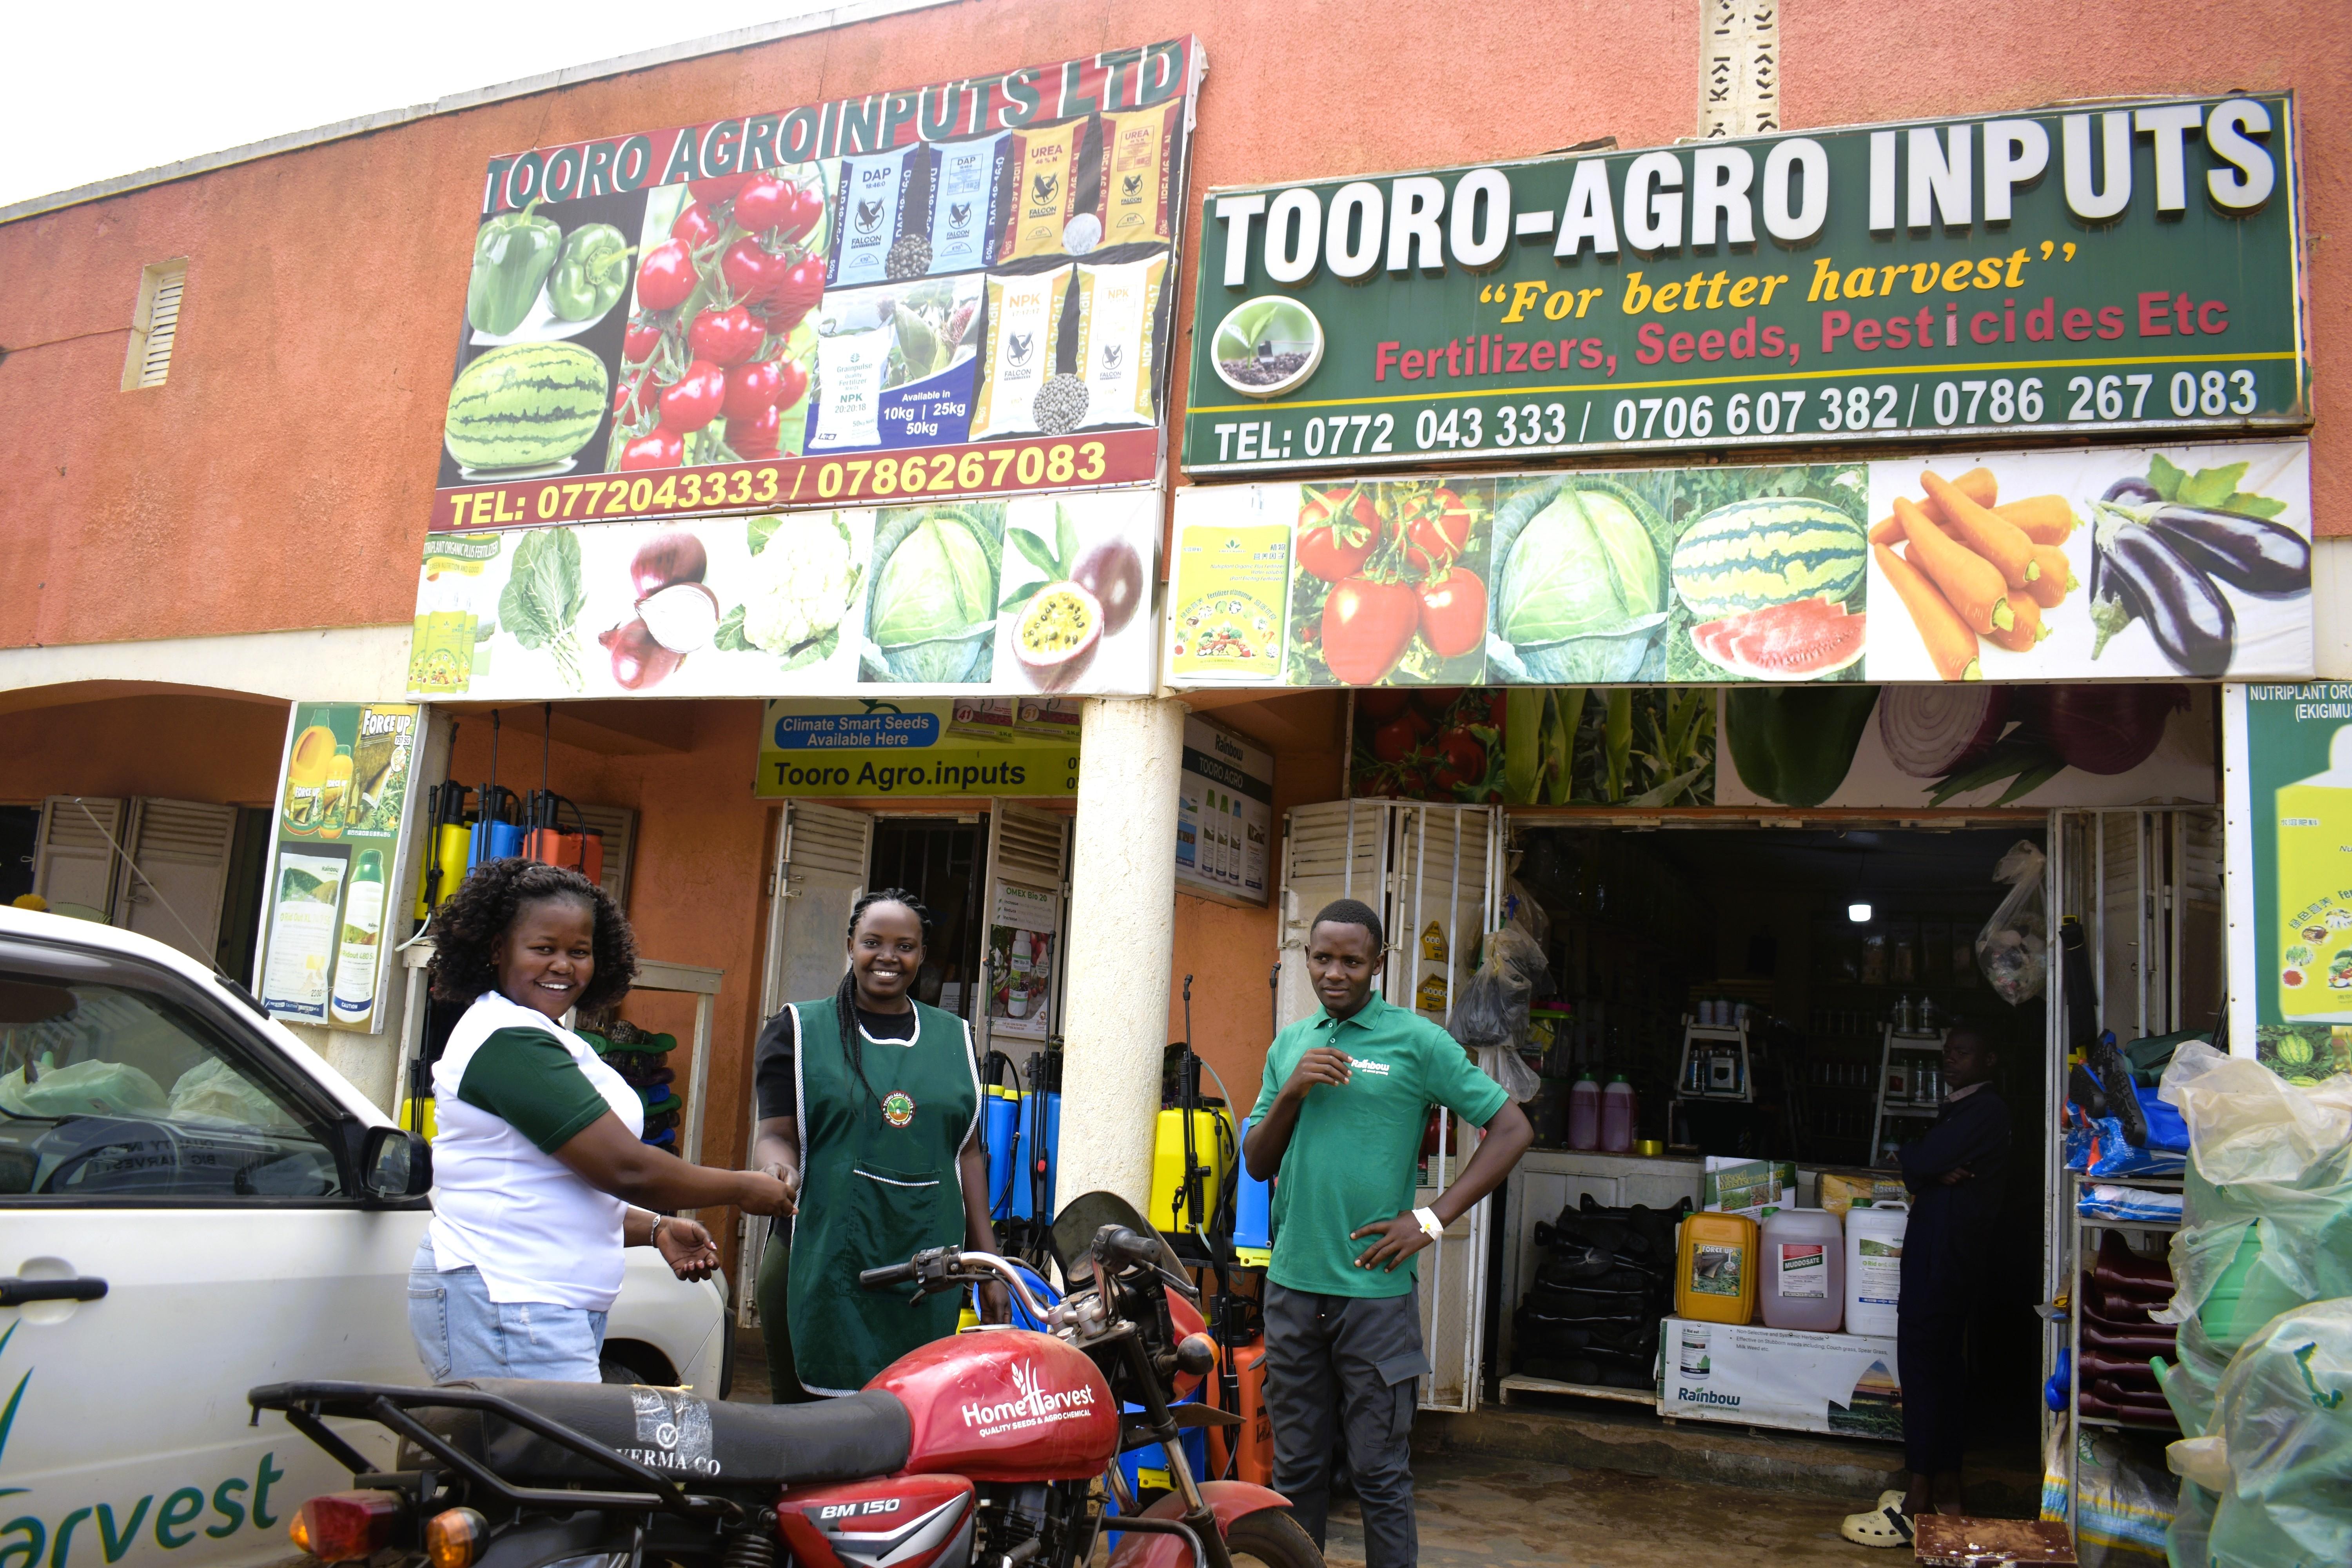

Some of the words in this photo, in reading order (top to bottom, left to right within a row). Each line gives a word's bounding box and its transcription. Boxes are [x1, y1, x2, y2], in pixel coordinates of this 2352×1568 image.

[485, 136, 651, 212] TOORO
[662, 66, 1040, 186] AGROINPUTS
[1056, 40, 1185, 116] LTD
[1125, 130, 1149, 140] UREA
[1031, 145, 1063, 158] UREA
[957, 156, 976, 166] DAP
[862, 167, 891, 183] DAP
[865, 181, 886, 189] 18:46:0
[1215, 138, 1829, 287] TOORO-AGRO
[1869, 99, 2275, 230] INPUTS
[1029, 206, 1056, 215] FALCON
[851, 235, 882, 245] FALCON
[946, 229, 970, 238] FALCON
[985, 239, 995, 261] 50kg
[827, 259, 836, 280] 50kg
[1108, 289, 1129, 299] NPK
[1622, 270, 1788, 315] better
[1009, 293, 1041, 308] NPK
[1079, 290, 1091, 315] NPK
[988, 302, 1000, 327] NPK
[1012, 308, 1040, 317] 17:17:17
[1375, 334, 1618, 381] Fertilizers,
[1635, 314, 1800, 366] Seeds,
[2138, 291, 2229, 338] Etc
[837, 363, 873, 373] Grainpulse
[1004, 368, 1032, 377] FALCON
[839, 378, 867, 386] Fertilizer
[840, 392, 863, 403] NPK
[902, 391, 940, 402] Available
[942, 390, 951, 398] in
[835, 403, 866, 414] 20:20:18
[884, 407, 915, 421] 10kg
[933, 402, 966, 416] 25kg
[975, 406, 987, 424] 50kg
[1214, 423, 1291, 462] TEL:
[1305, 413, 1394, 456] 0772
[1416, 407, 1483, 450] 043
[1495, 403, 1566, 446] 333
[1613, 394, 1713, 439] 0706
[1726, 391, 1806, 436] 607
[1819, 385, 1898, 431] 382
[1933, 377, 2044, 426] 0786
[2068, 374, 2153, 421] 267
[2170, 369, 2258, 417] 083
[906, 422, 938, 436] 50kg
[451, 492, 526, 524] TEL:
[537, 467, 780, 518] 0772043333
[816, 442, 1107, 494] 0786267083
[445, 541, 465, 556] ORGANIC
[464, 544, 475, 558] PLUS
[475, 541, 498, 559] FERTILIZER
[429, 562, 440, 571] GREEN
[441, 562, 460, 571] NUTRITION
[1207, 590, 1229, 600] Fertilizer
[2250, 684, 2327, 701] NUTRIPLANT
[958, 709, 972, 720] 41
[1024, 708, 1037, 719] 51
[783, 716, 835, 732] Climate
[839, 717, 882, 731] Smart
[885, 715, 929, 730] Seeds
[806, 732, 871, 748] Available
[875, 733, 909, 746] Here
[1216, 733, 1243, 762] Rainbow
[774, 762, 850, 786] Tooro
[1199, 757, 1223, 780] TOORO
[1224, 768, 1243, 788] AGRO
[1006, 887, 1026, 898] OMEX
[1027, 891, 1038, 900] Bio
[1039, 894, 1047, 902] 20
[1351, 1059, 1390, 1071] Rainbow
[1784, 1257, 1820, 1269] MUDDOSATE
[1678, 1387, 1740, 1406] Rainbow
[979, 1423, 1011, 1438] QUALITY
[1012, 1418, 1037, 1430] SEEDS
[1044, 1413, 1063, 1423] AGRO
[1063, 1409, 1091, 1420] CHEMICAL
[820, 1503, 857, 1519] BM
[862, 1498, 900, 1515] 150
